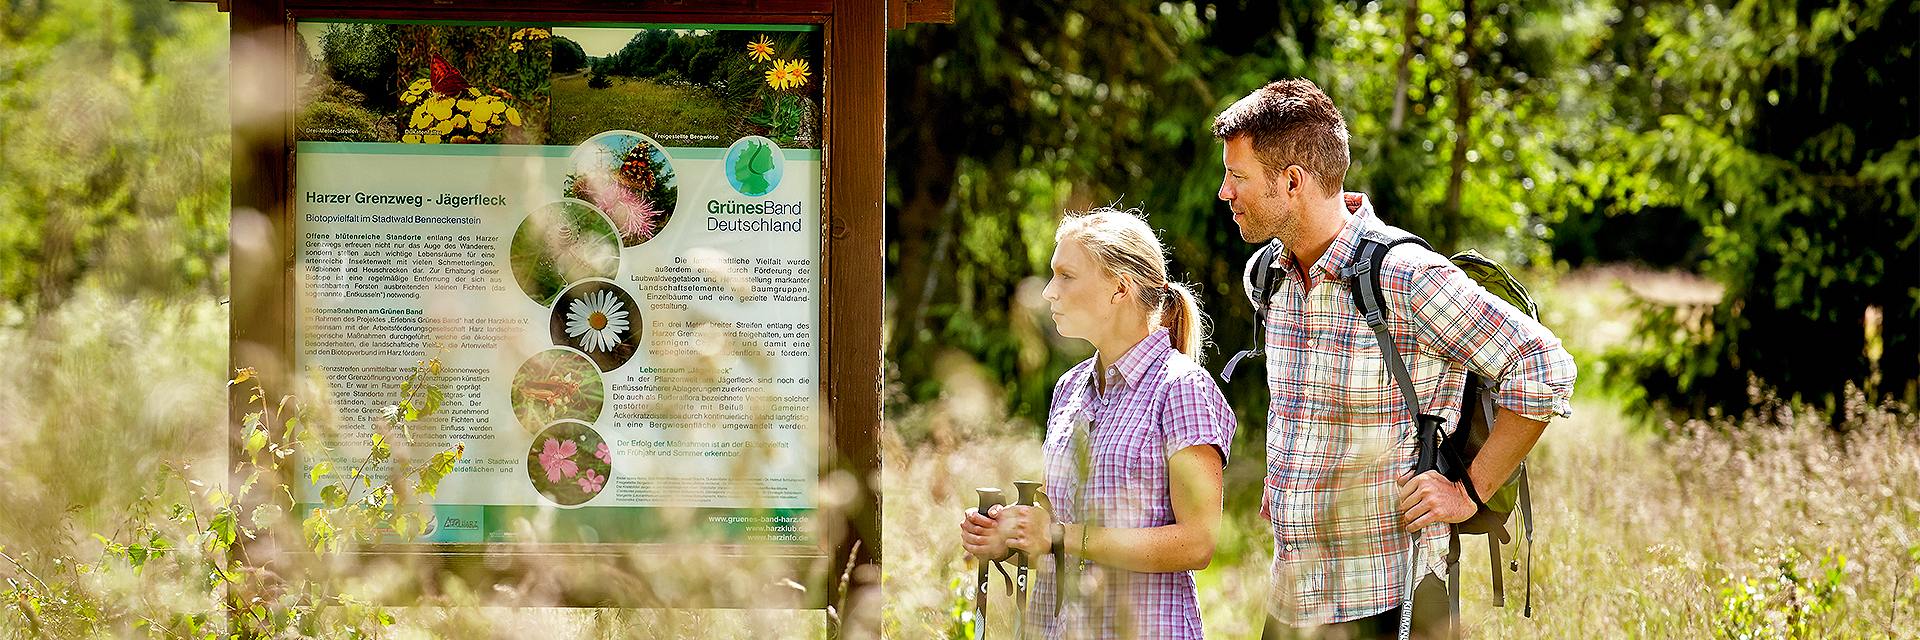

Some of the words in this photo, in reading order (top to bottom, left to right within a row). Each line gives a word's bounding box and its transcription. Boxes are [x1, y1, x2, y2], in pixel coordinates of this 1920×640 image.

[306, 192, 350, 203] Harzer
[355, 192, 423, 207] Grenzweg
[436, 193, 506, 207] Jägerfleck
[707, 200, 801, 215] GrünesBand
[306, 214, 359, 224] Biotopvielfalt
[372, 215, 413, 223] Stadtwald
[415, 216, 481, 224] Benneckenstein
[708, 218, 801, 232] Deutschland
